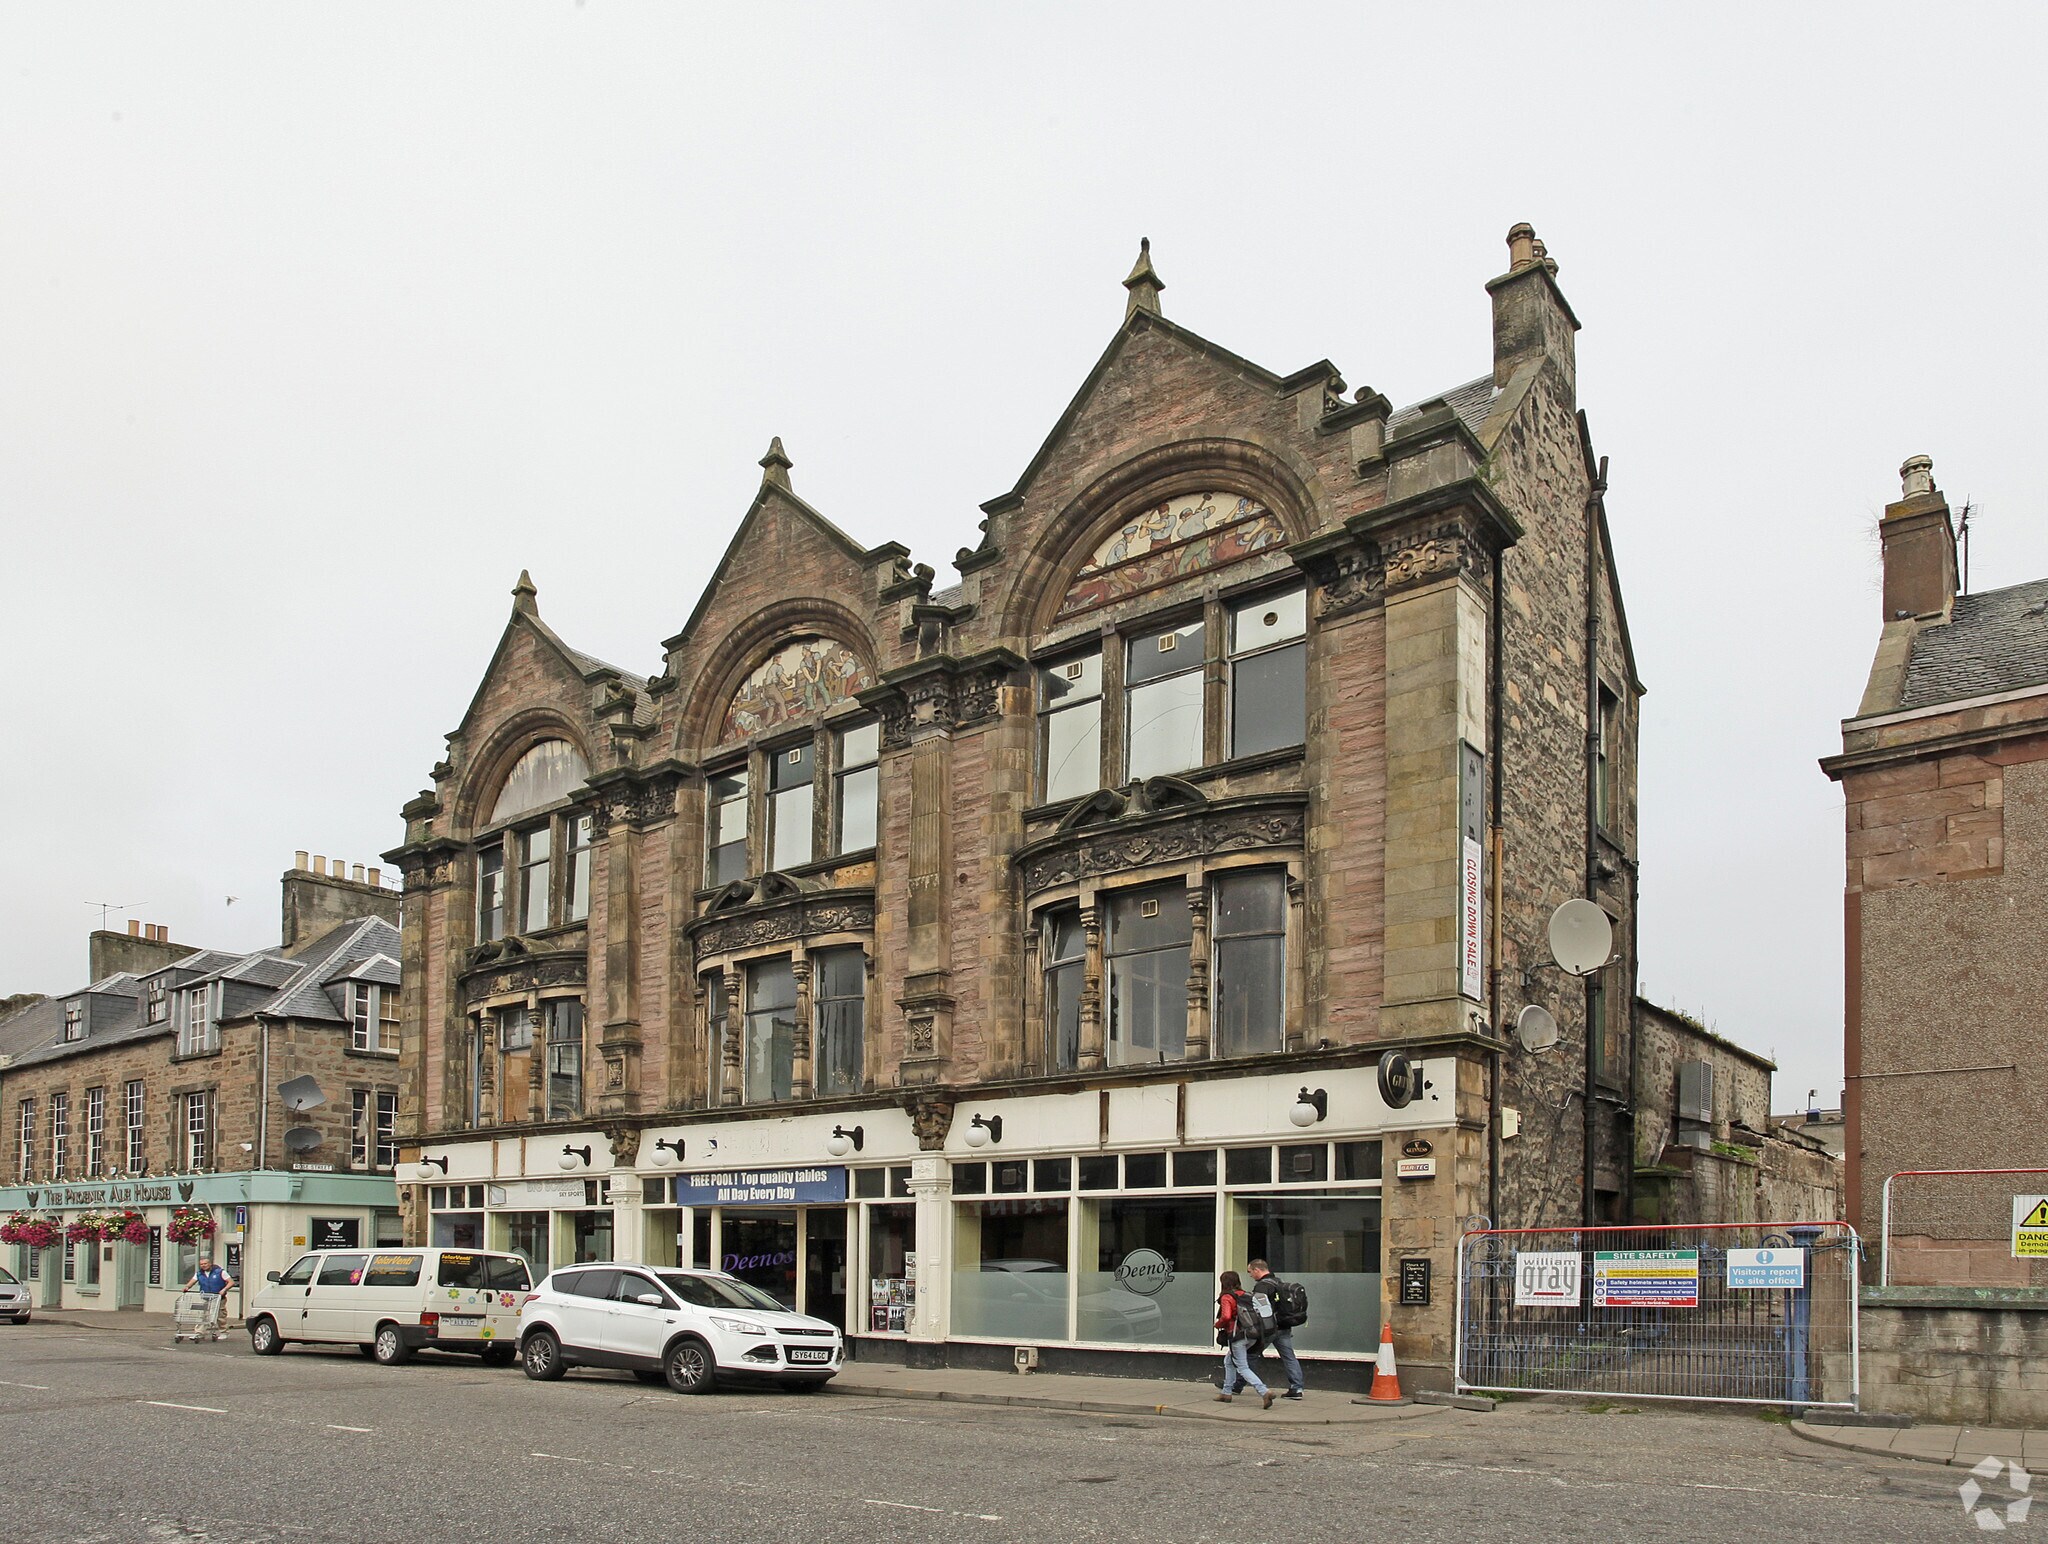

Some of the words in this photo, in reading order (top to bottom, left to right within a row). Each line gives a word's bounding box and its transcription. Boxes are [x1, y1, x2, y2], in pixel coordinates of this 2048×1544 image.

[1467, 858, 1477, 905] CLOSING
[1467, 905, 1477, 940] DOWN
[1467, 940, 1477, 967] SALE
[690, 1174, 710, 1187] FREE
[741, 1172, 760, 1186] Top
[760, 1171, 794, 1185] quality
[795, 1169, 828, 1183] tables
[718, 1188, 730, 1201] All
[731, 1187, 749, 1201] Day
[750, 1187, 775, 1200] Every
[777, 1186, 796, 1200] Day
[1523, 1257, 1576, 1266] william
[1613, 1252, 1635, 1260] SITE
[1638, 1252, 1678, 1260] SAFETY
[1114, 1258, 1175, 1282] Deeno's
[1732, 1268, 1766, 1276] Visitors
[1770, 1268, 1799, 1277] report
[1522, 1266, 1576, 1296] gray
[794, 1351, 812, 1359] SY64
